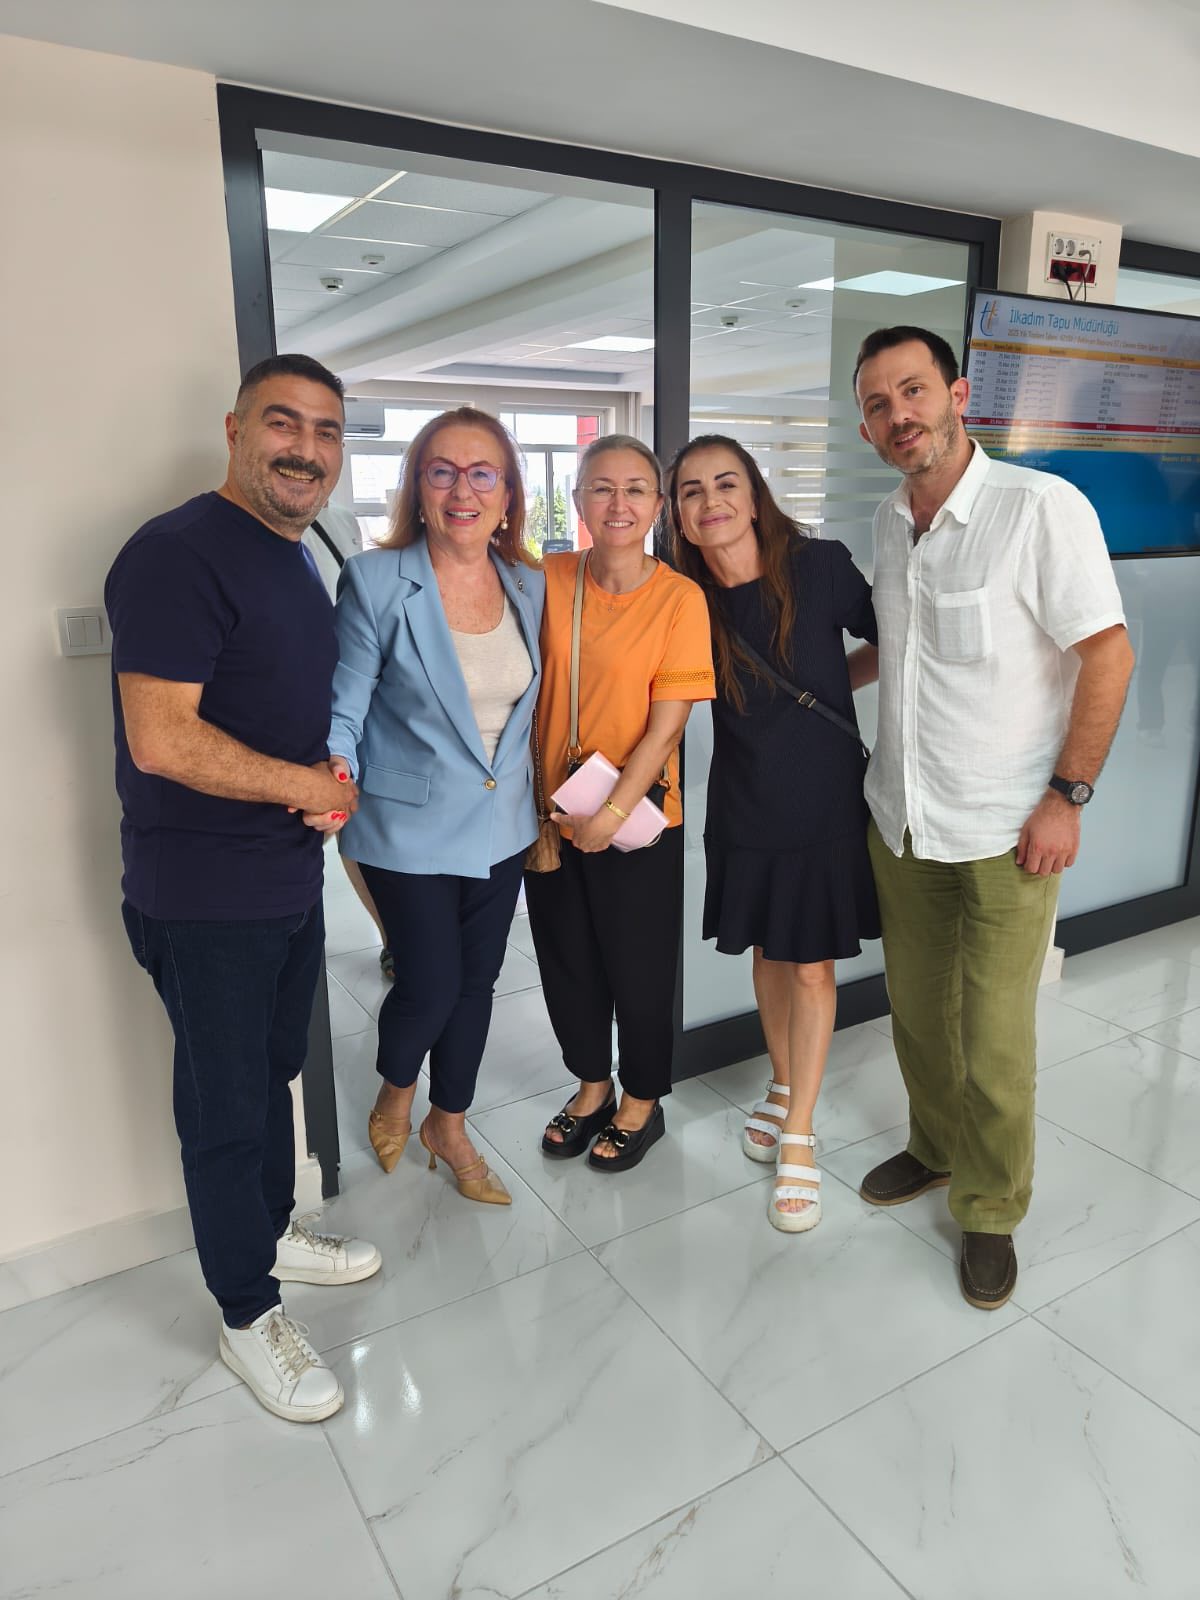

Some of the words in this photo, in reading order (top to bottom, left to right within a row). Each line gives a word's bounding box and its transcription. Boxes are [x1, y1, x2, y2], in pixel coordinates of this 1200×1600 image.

[1009, 307, 1045, 326] İlkadım
[1048, 314, 1071, 331] Tapu
[1072, 316, 1119, 336] Müdürlüğü
